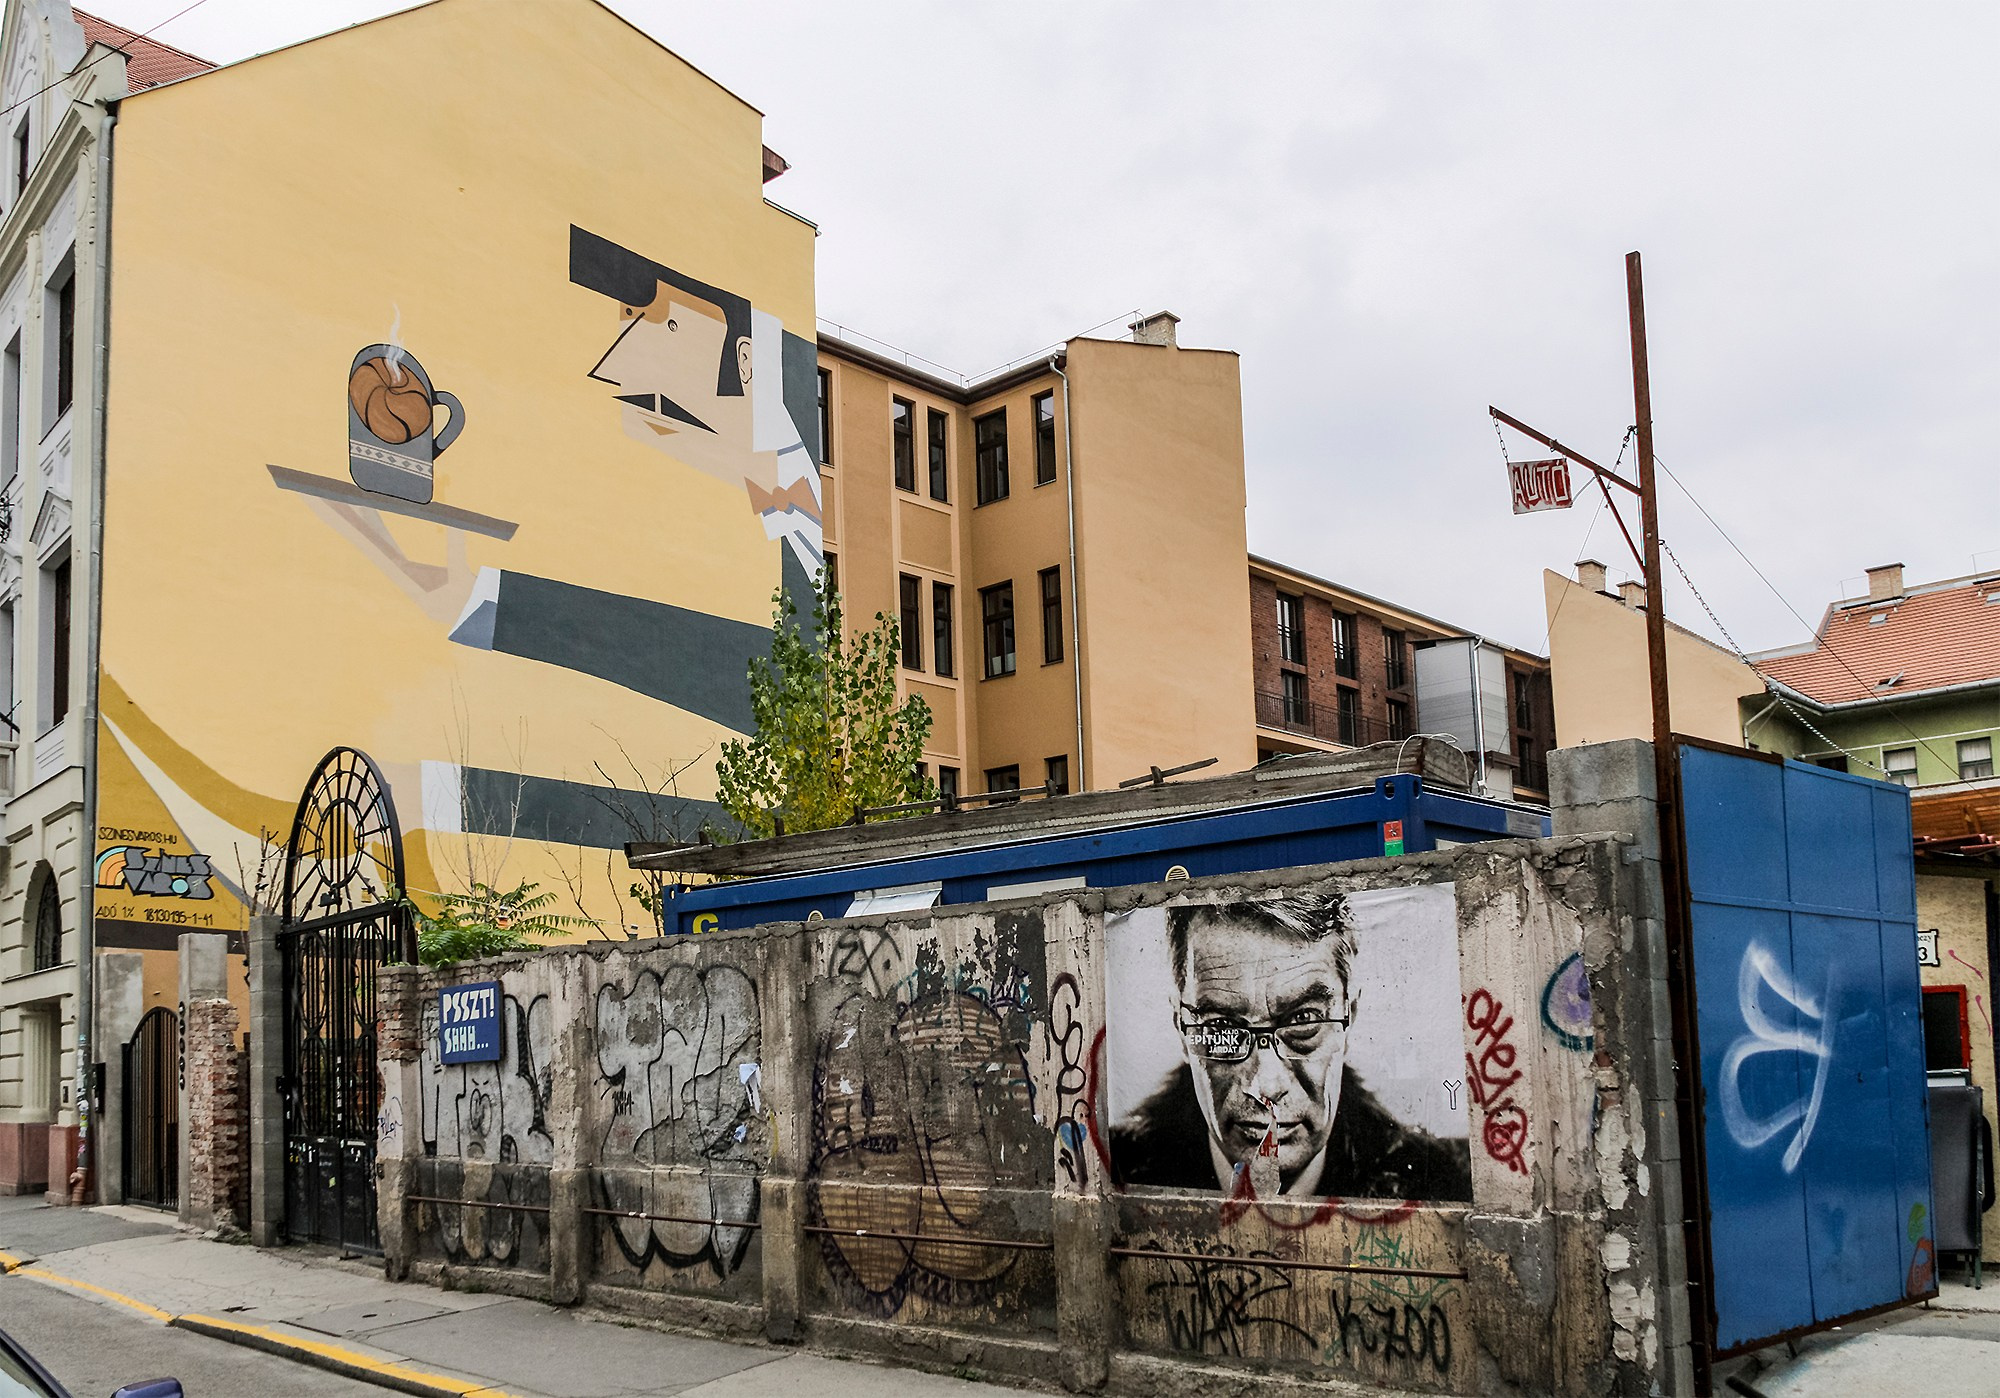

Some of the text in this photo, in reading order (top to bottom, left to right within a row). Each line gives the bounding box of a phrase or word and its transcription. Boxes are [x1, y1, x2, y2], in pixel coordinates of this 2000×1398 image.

[1513, 463, 1571, 508] AUTO
[94, 903, 117, 918] ADÓ
[443, 988, 495, 1024] PSSZT!
[444, 1026, 489, 1055] SHHH...
